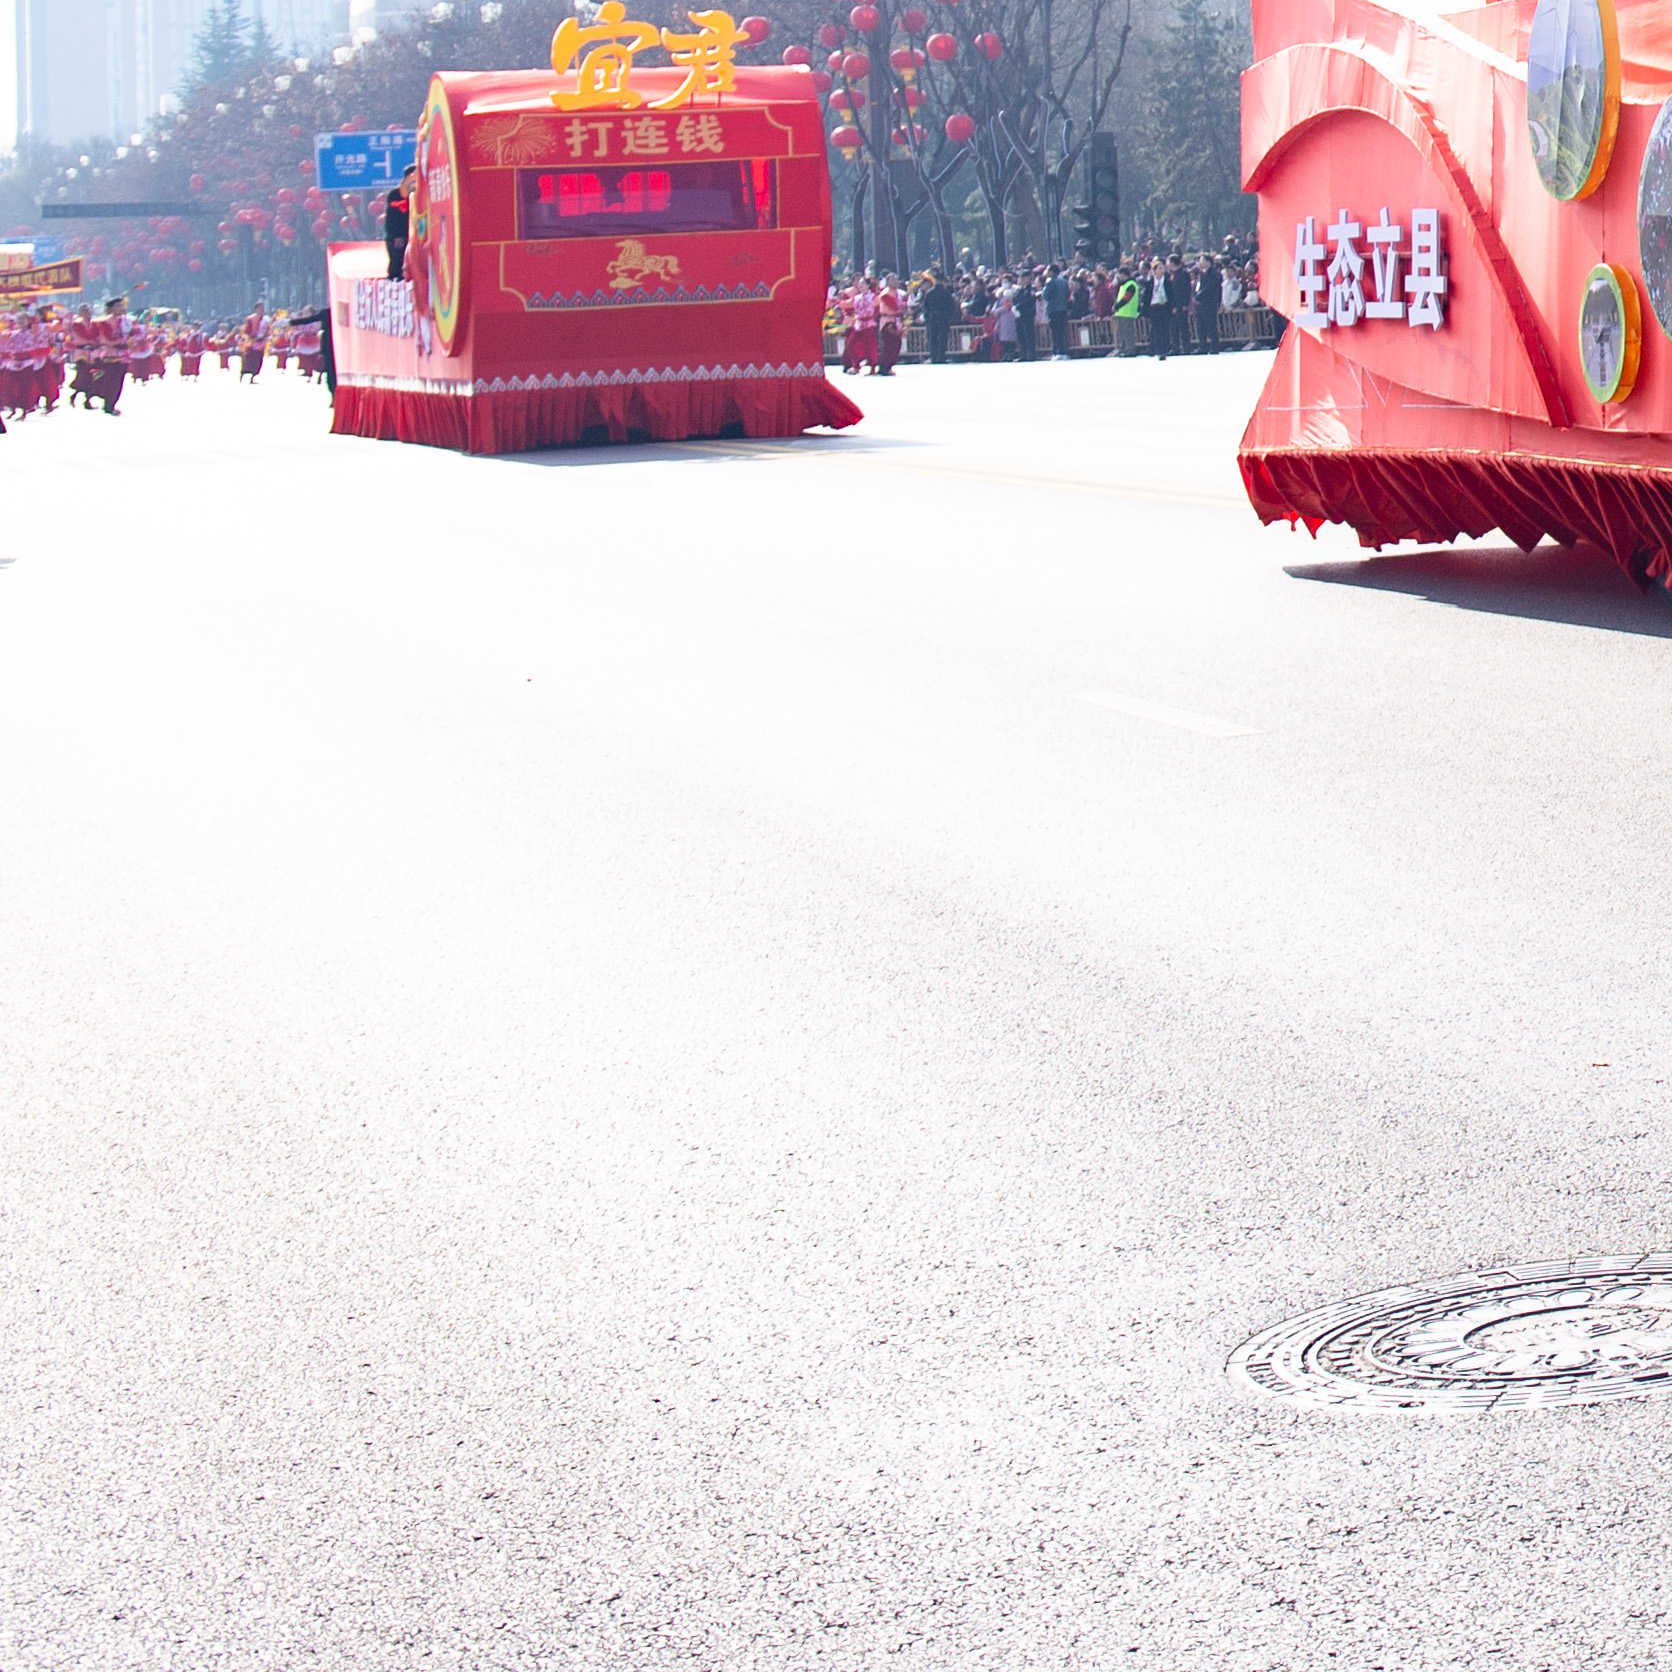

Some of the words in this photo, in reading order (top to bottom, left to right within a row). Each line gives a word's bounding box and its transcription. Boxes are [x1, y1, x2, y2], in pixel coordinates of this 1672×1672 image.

[549, 1, 750, 111] 宜君
[564, 114, 725, 158] 打连钱
[1294, 206, 1448, 332] 生态立县
